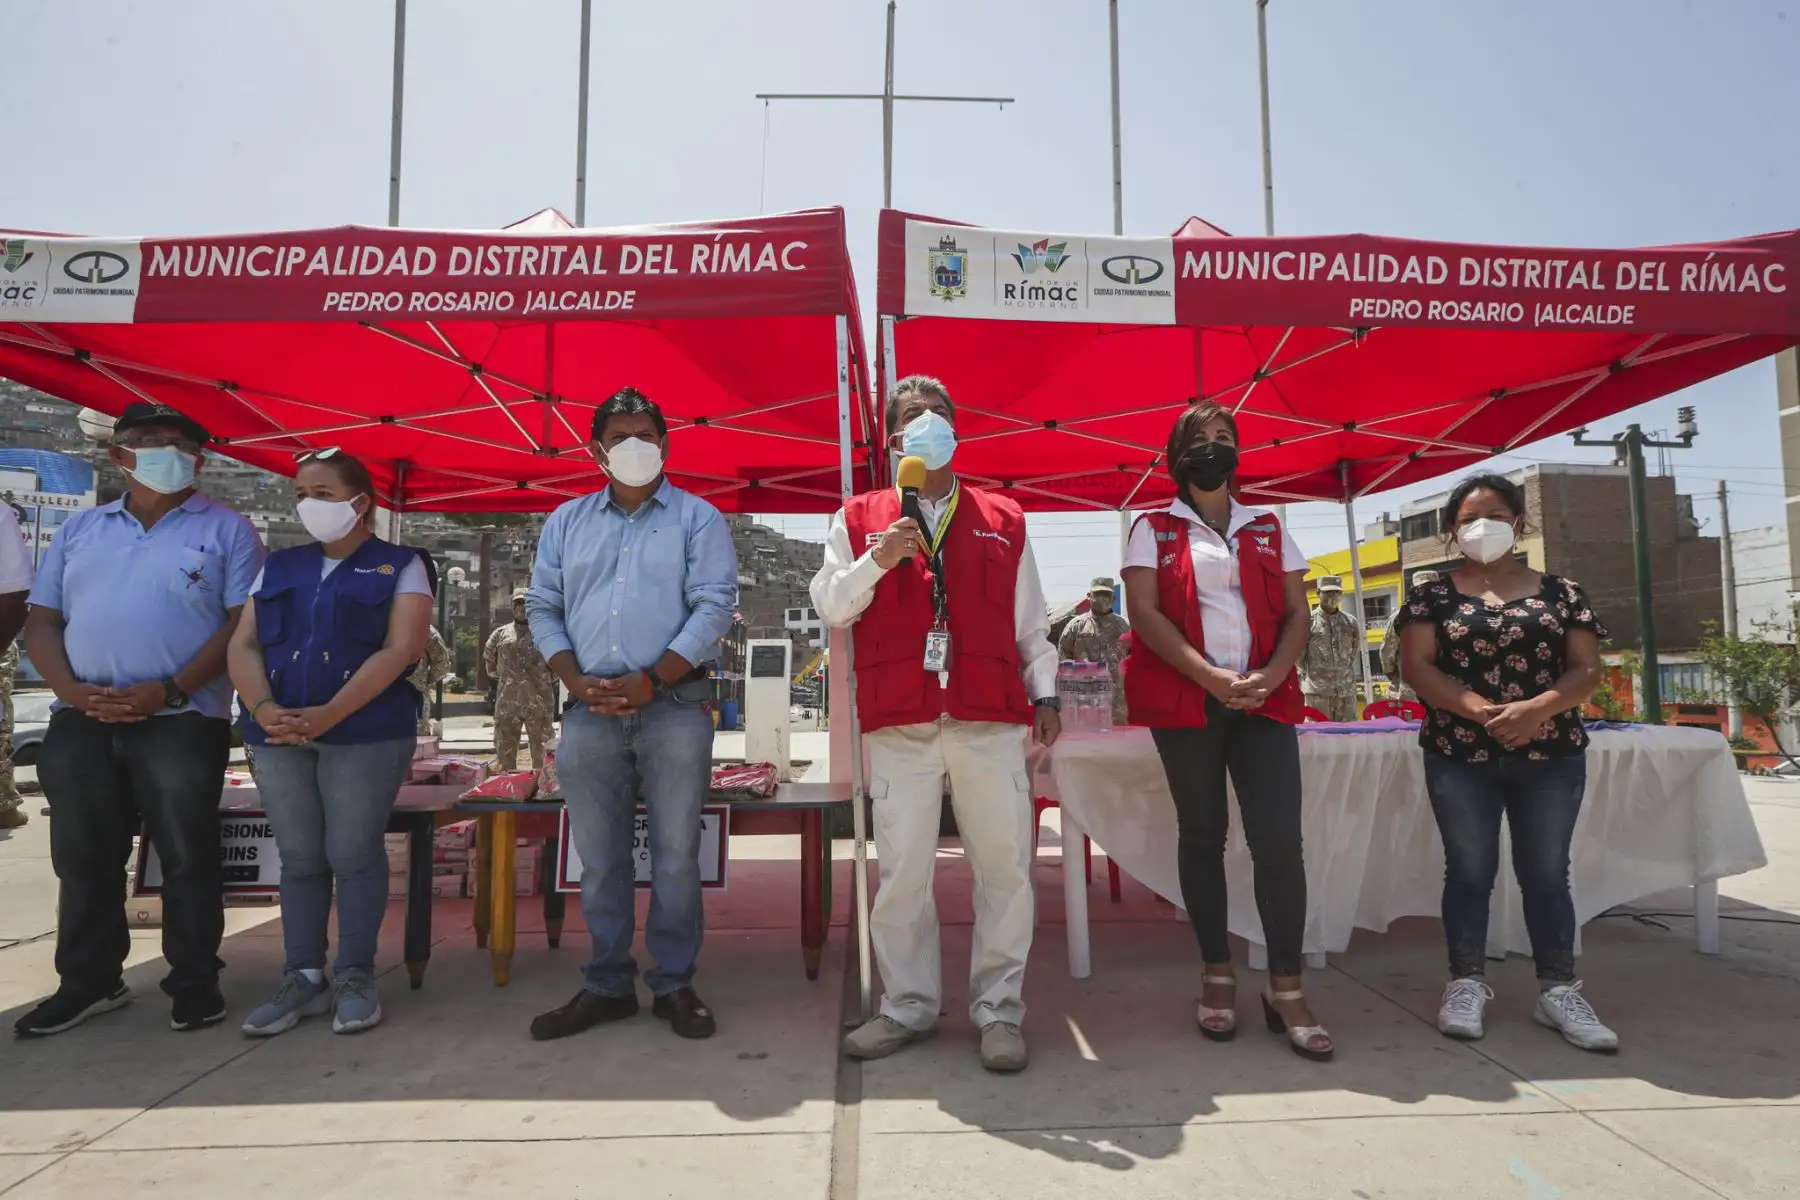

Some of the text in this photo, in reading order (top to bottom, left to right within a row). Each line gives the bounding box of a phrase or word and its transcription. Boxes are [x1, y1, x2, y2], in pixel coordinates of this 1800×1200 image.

[147, 232, 808, 277] MUNICIPALIDAD DISTRITAL DEL RÍMAC
[1182, 250, 1787, 293] MUNICIPALIDAD DISTRITAL DEL RÍMAC
[1004, 280, 1078, 301] Rímac
[1094, 288, 1172, 298] CIUDAD PATRIMONIO MUNDIAL
[323, 291, 404, 312] PEDRO
[408, 291, 515, 312] ROSARIO
[1004, 300, 1078, 310] MODERNO
[1349, 298, 1423, 319] PEDRO
[1427, 300, 1524, 322] ROSARIO
